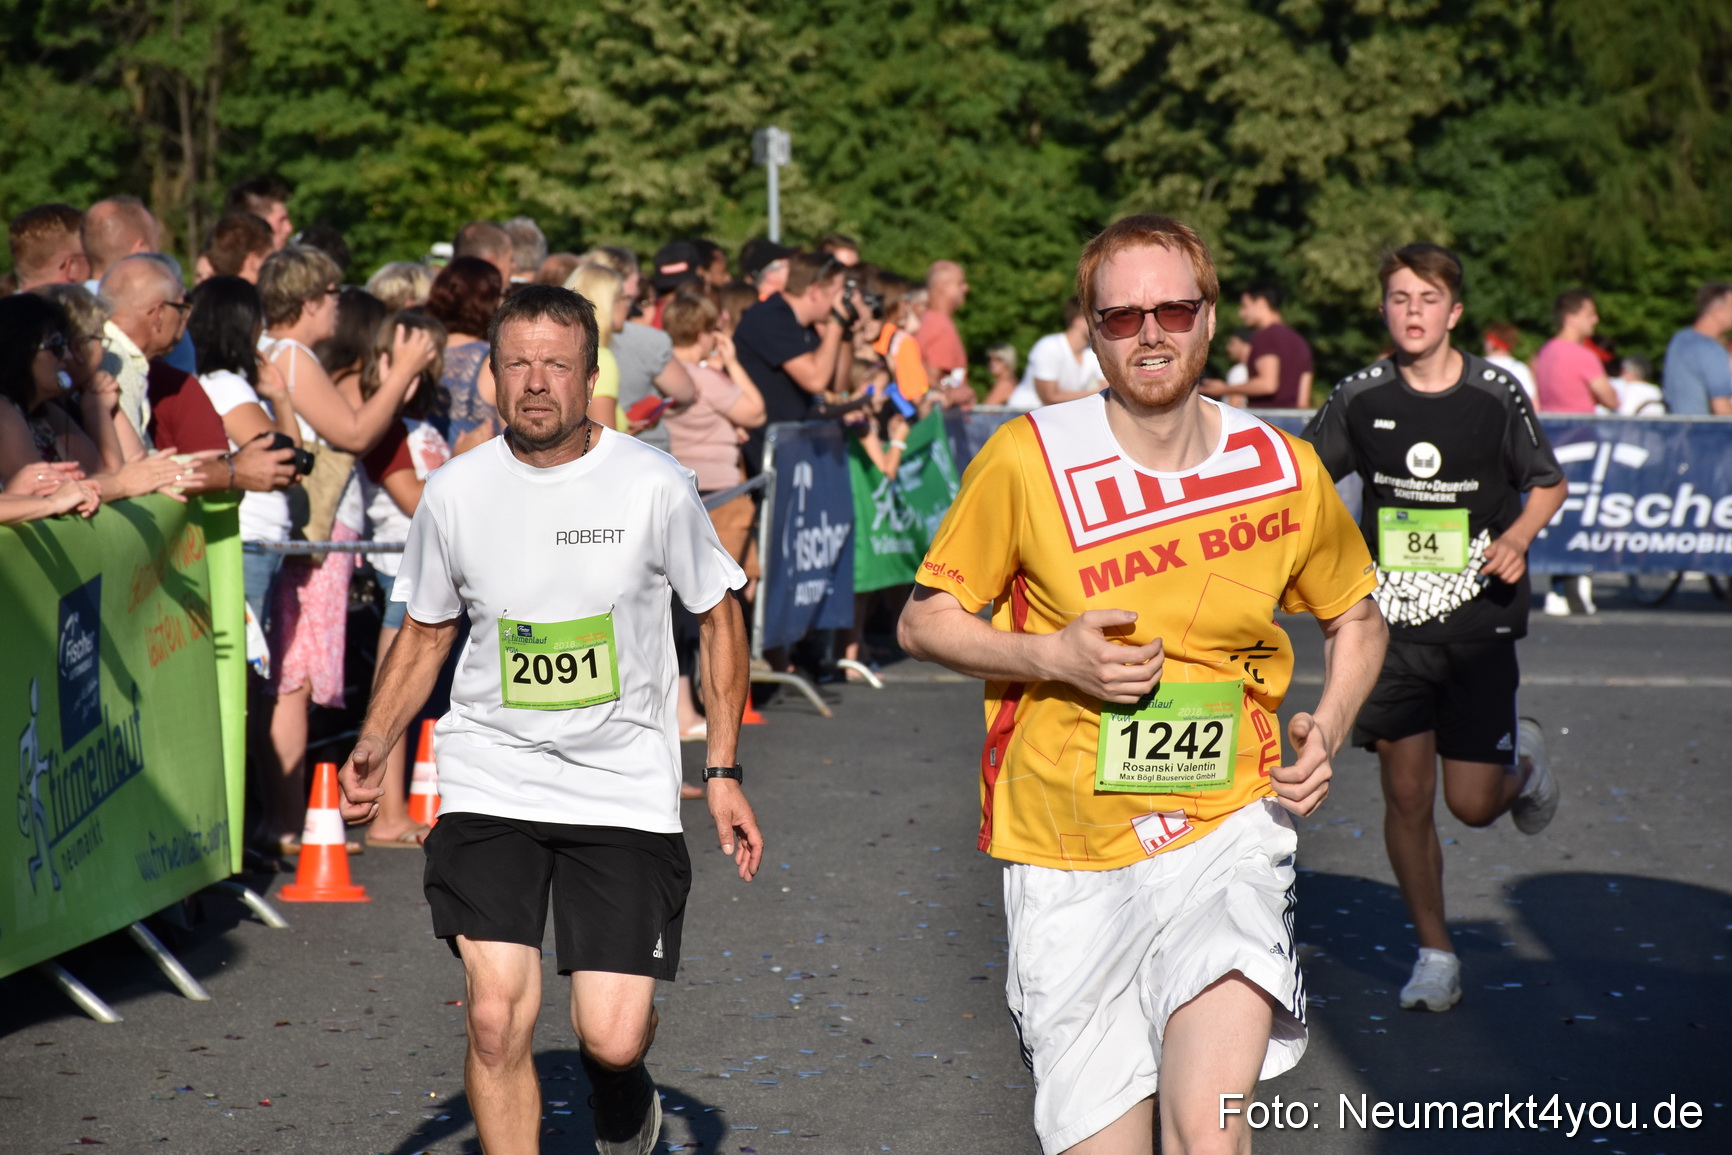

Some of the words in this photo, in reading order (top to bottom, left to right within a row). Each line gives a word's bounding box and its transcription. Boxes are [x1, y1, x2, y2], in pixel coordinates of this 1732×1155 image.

[556, 529, 625, 546] ROBERT
[1407, 532, 1439, 554] 84
[1079, 539, 1188, 598] MAX
[1199, 508, 1301, 561] BÖGL
[511, 634, 548, 645] firmenlauf
[553, 641, 576, 650] 2018
[512, 648, 598, 686] 2091
[1178, 707, 1203, 717] 2018
[1120, 721, 1224, 760] 1242
[48, 681, 144, 840] firmenlauf
[1122, 762, 1174, 772] Rosanski
[1176, 762, 1216, 772] Valentin
[1119, 773, 1135, 781] Max
[1137, 773, 1155, 783] Bögl
[1156, 773, 1195, 781] Bauservice
